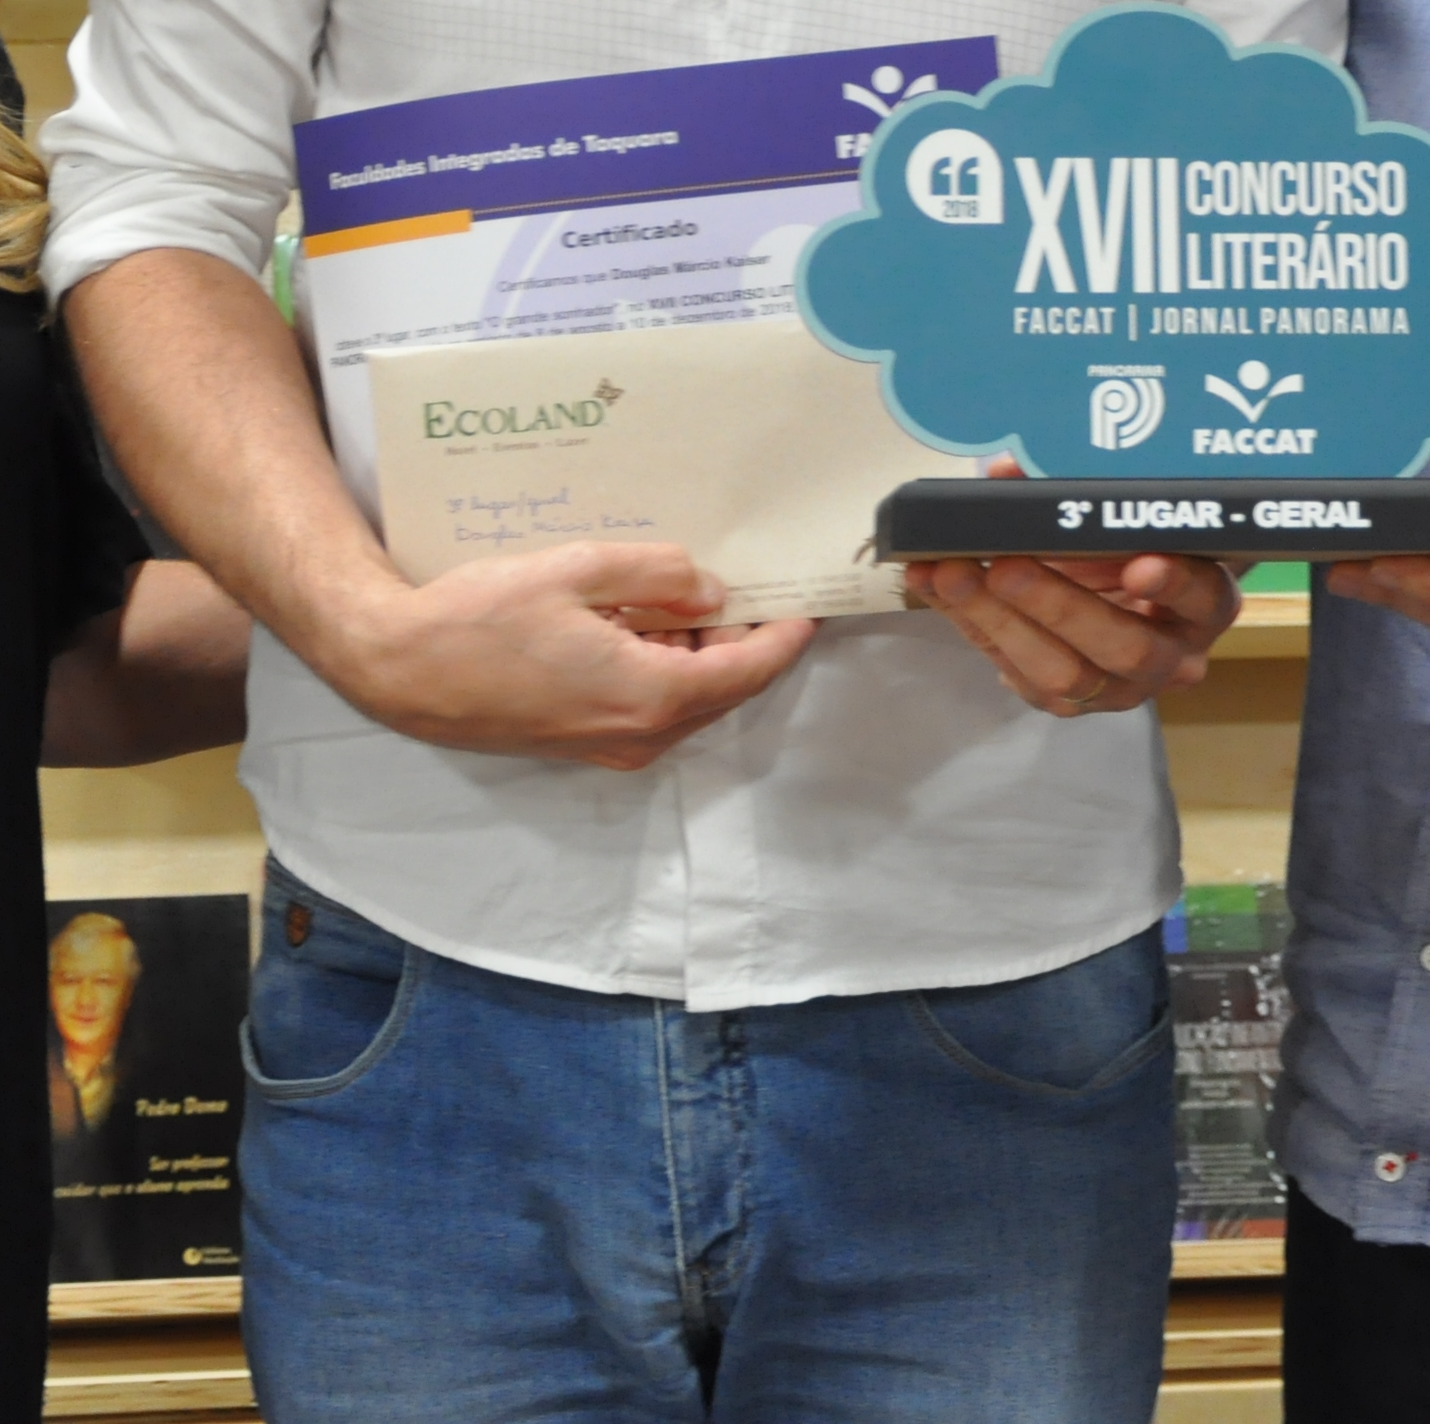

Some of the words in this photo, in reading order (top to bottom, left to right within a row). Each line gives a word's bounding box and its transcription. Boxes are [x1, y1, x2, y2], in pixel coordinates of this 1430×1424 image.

[329, 160, 427, 190] Faculdades
[428, 143, 546, 172] Integradas
[548, 137, 580, 157] de
[582, 131, 679, 154] Taquara
[1185, 160, 1409, 216] CONCURSO
[942, 199, 979, 218] 2018
[1013, 157, 1180, 293] XVII
[561, 220, 699, 249] Certificado
[1186, 220, 1410, 290] LITERÁRIO
[1013, 307, 1115, 334] FACCAT
[1149, 307, 1255, 334] JORNAL
[1260, 307, 1410, 334] PANORAMA
[424, 399, 604, 439] ECOLAND
[1192, 429, 1318, 455] FACCAT
[1101, 500, 1224, 528] LUGAR
[1253, 500, 1372, 528] GERAL
